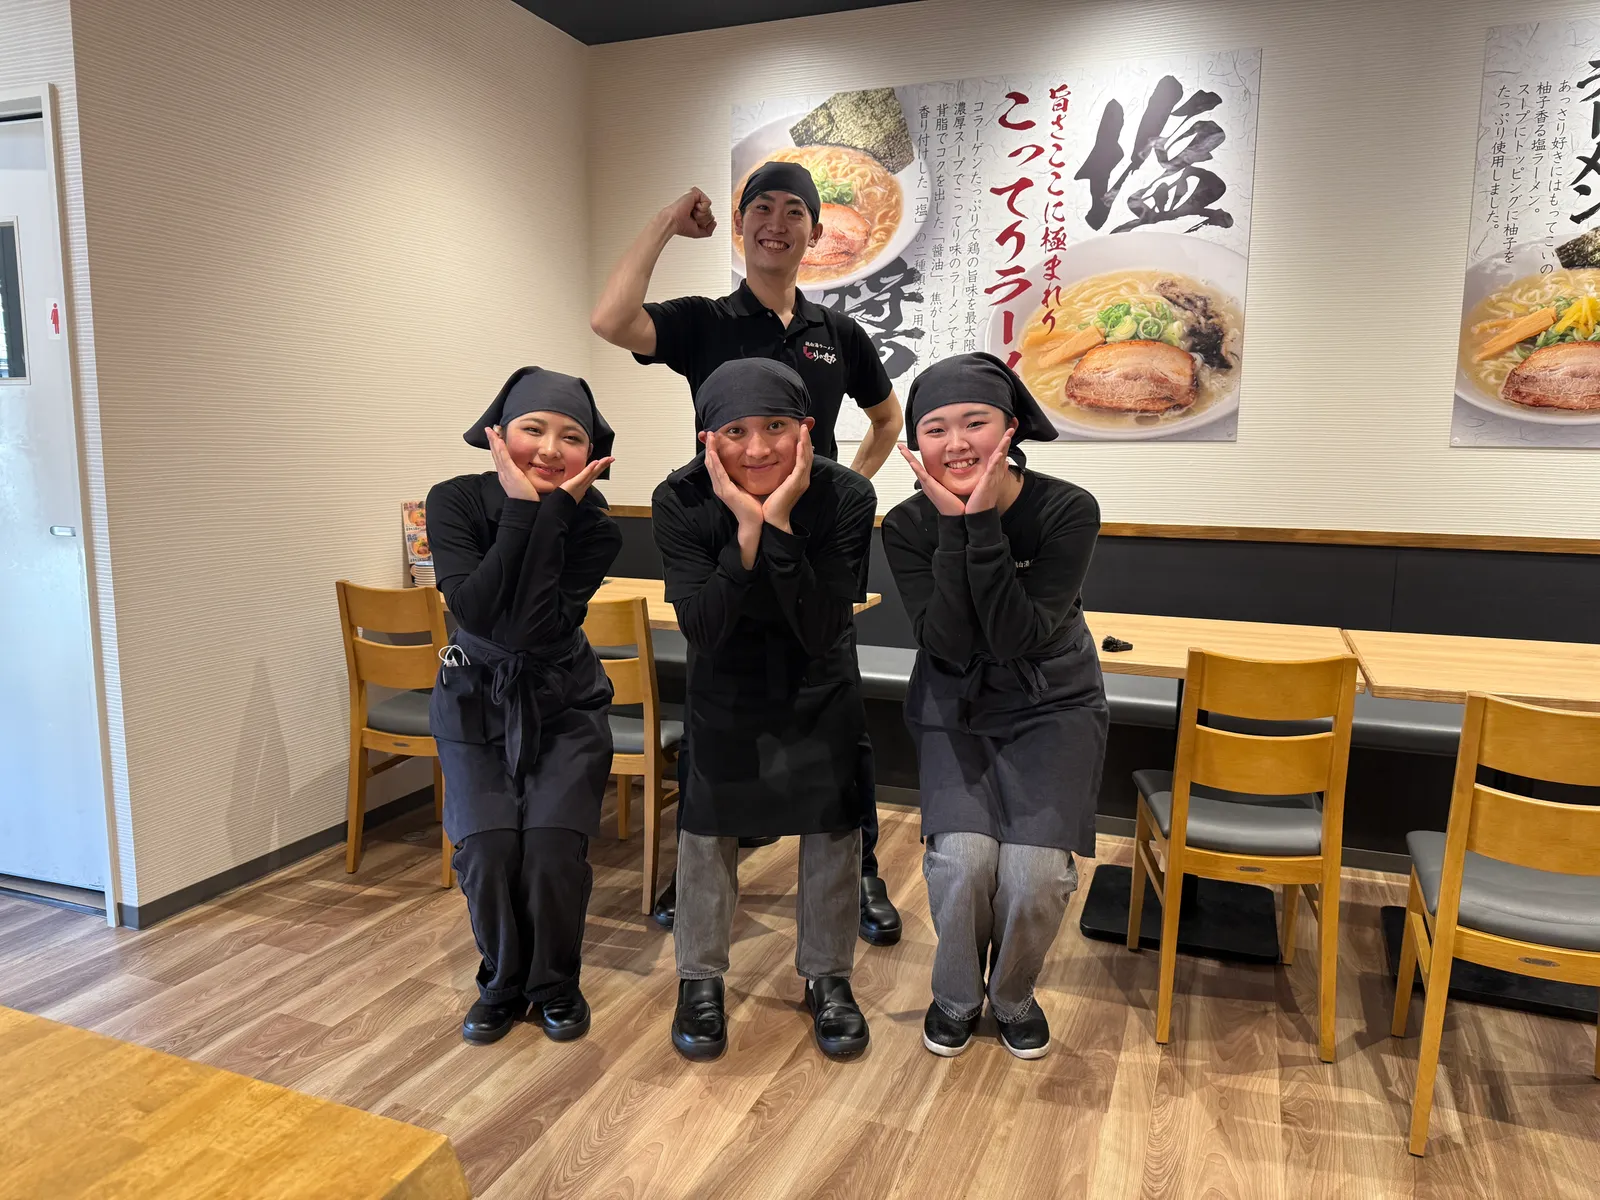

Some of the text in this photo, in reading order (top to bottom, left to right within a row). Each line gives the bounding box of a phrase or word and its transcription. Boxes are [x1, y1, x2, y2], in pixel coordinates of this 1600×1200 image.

[929, 103, 949, 364] 背脂でコクを出した「醤油」、焦がしにん
[963, 101, 984, 351] コラーゲンたっぷりで鶏の旨味を最大限
[1040, 84, 1071, 335] 旨さここに極まれり
[1074, 75, 1234, 234] 塩
[1486, 84, 1511, 229] たっぷり使用しました。
[1503, 84, 1530, 264] スープにトッピングに柚子を
[1528, 80, 1552, 213] 柚子香る塩ラーメン。
[1540, 79, 1571, 274] あっさり好きにはもってこいの
